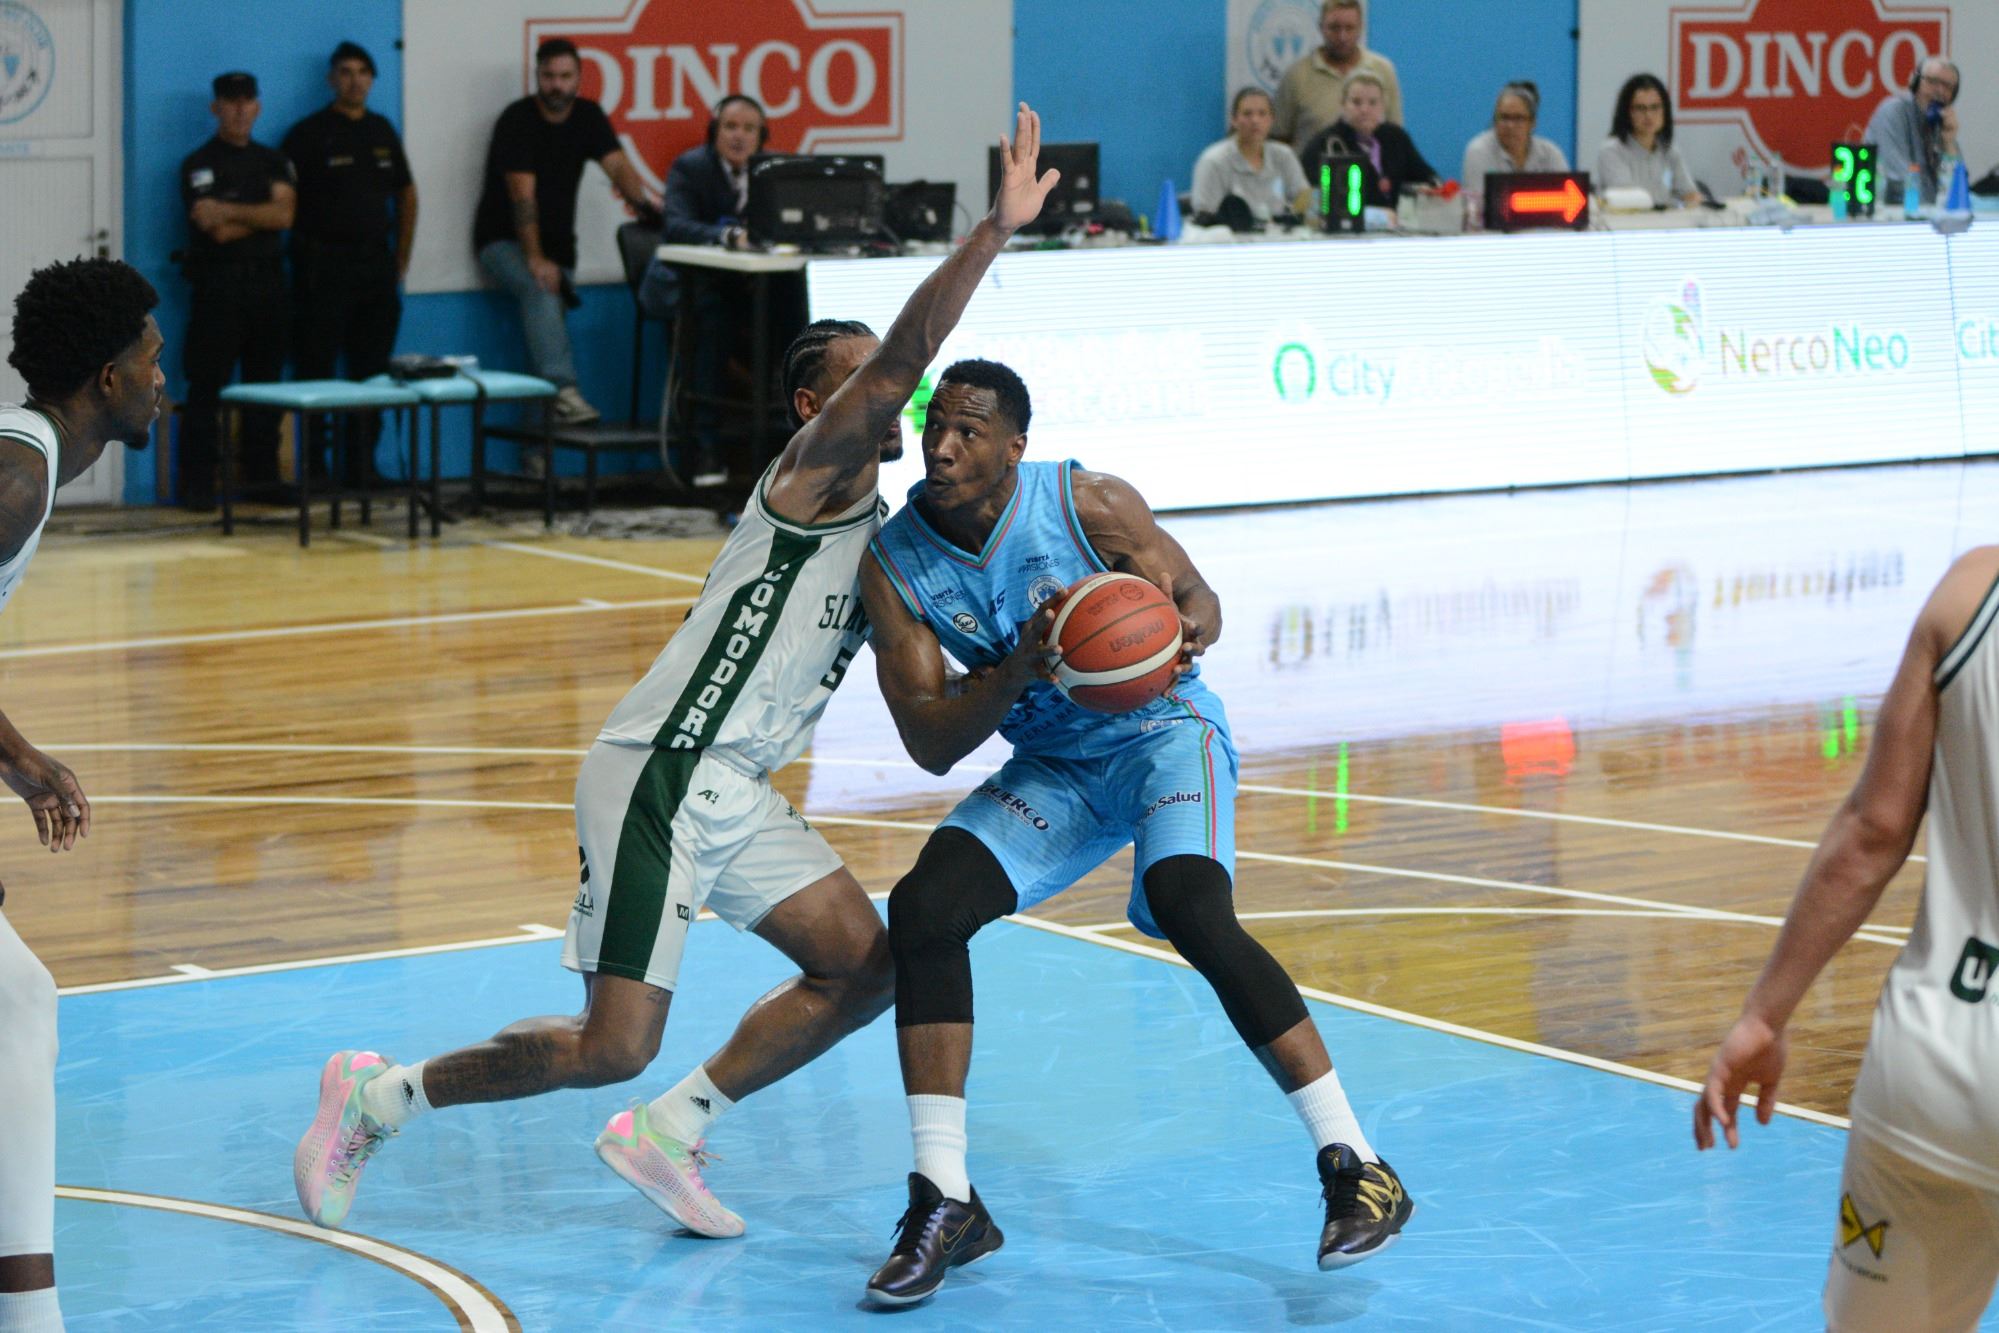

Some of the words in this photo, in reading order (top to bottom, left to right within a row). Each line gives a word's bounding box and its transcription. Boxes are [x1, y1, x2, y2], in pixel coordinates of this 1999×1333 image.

[1688, 30, 1929, 98] DINCO
[1720, 323, 1909, 376] NercoNeo
[1109, 618, 1165, 653] molten
